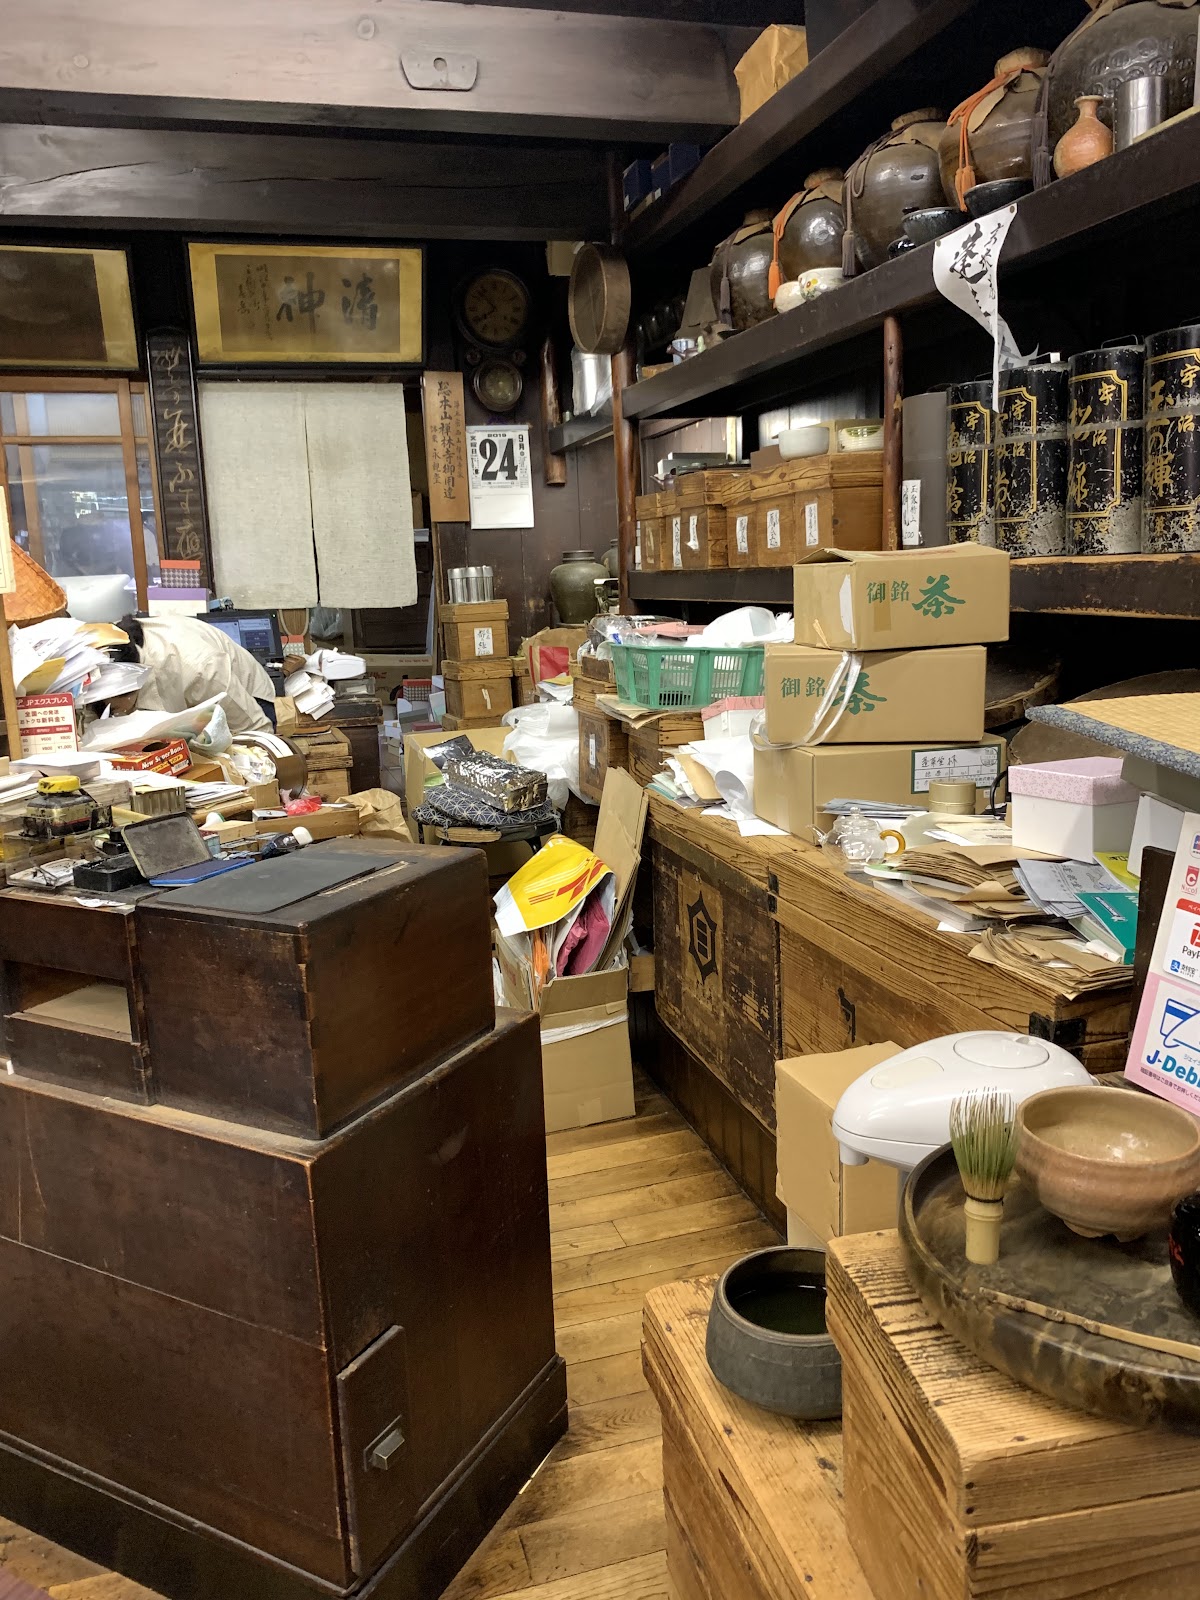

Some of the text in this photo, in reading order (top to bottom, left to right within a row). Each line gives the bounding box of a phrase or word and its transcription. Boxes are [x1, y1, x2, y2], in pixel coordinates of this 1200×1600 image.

[479, 438, 519, 481] 24
[866, 574, 966, 619] 御銘茶
[26, 696, 68, 707] JPエクスプレス
[141, 760, 154, 770] New
